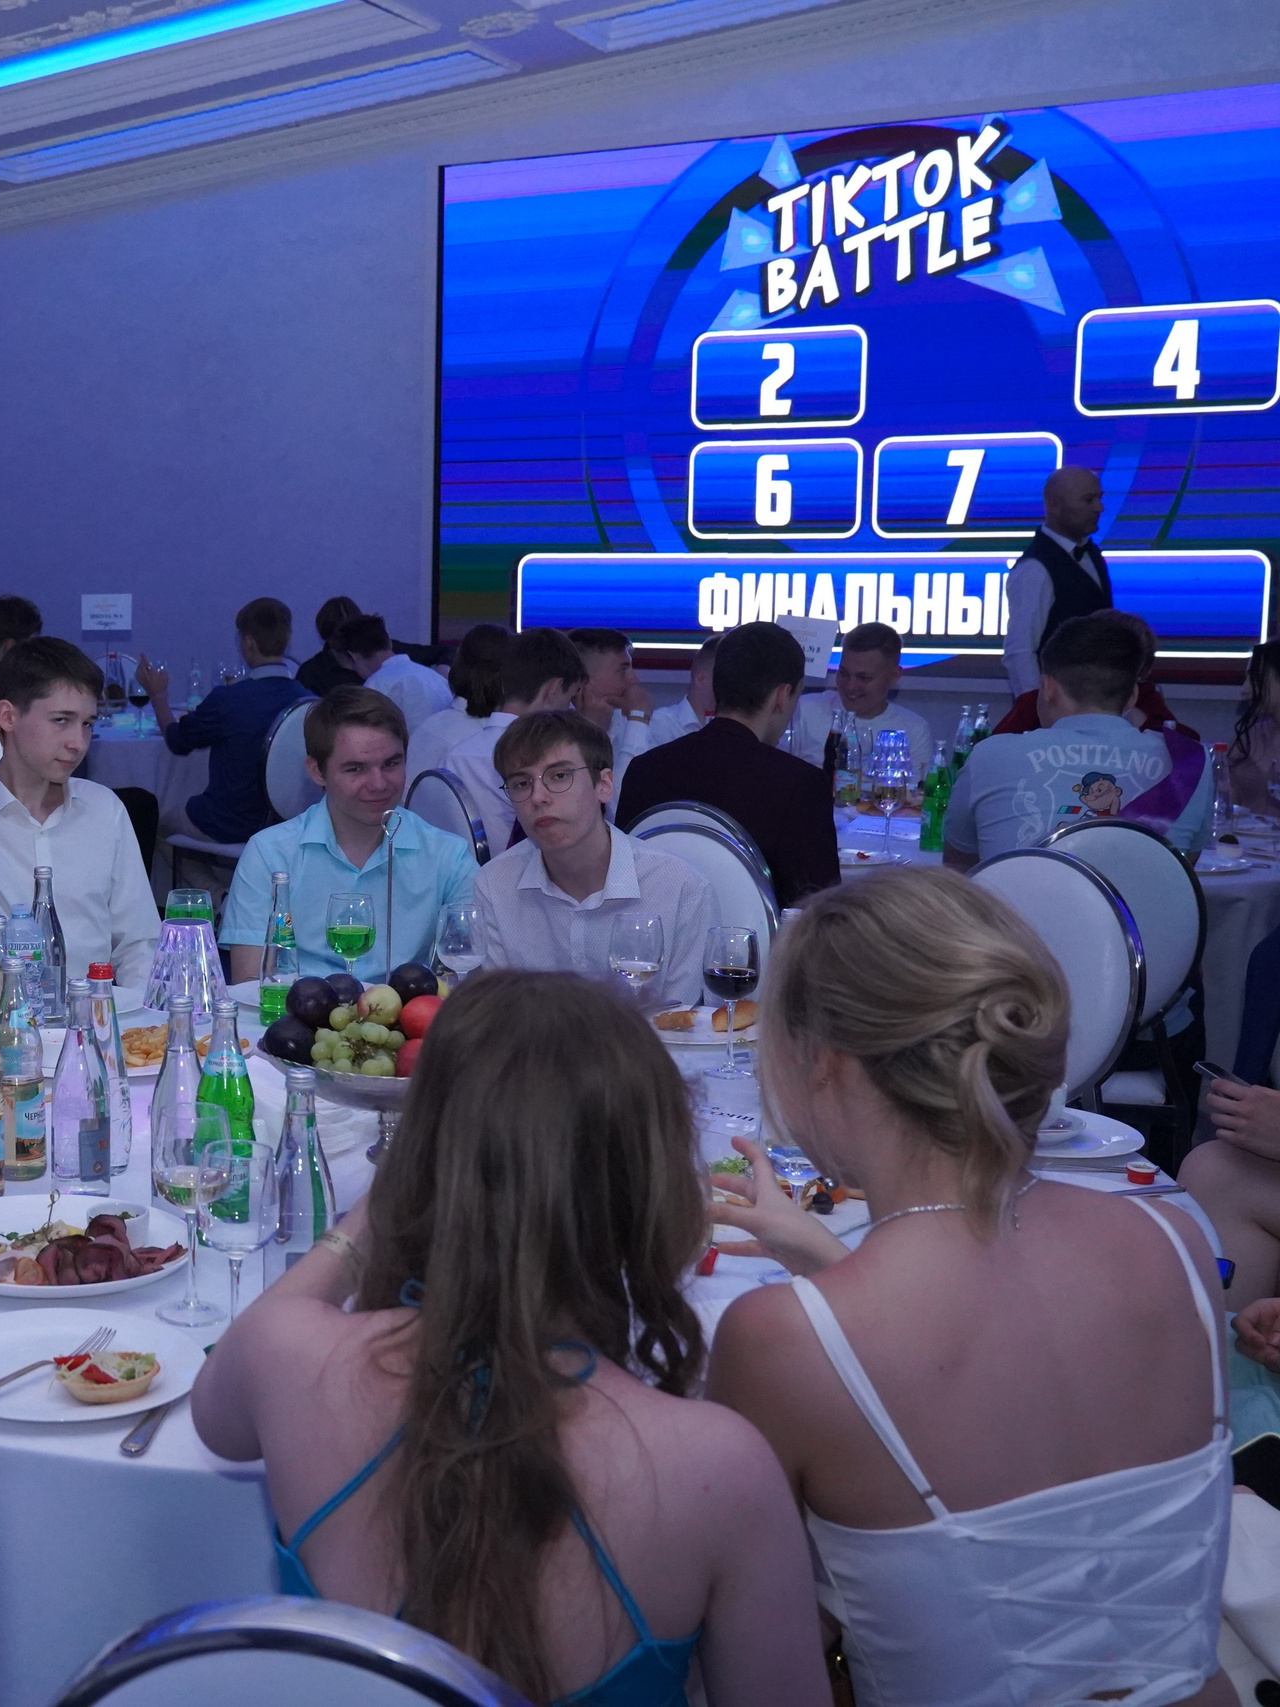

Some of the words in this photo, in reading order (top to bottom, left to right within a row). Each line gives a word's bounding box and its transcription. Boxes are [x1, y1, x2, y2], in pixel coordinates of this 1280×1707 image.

[767, 124, 1001, 253] TIKTOK
[767, 196, 994, 314] BATTLE
[760, 342, 795, 417] 2
[1152, 320, 1201, 400] 4
[754, 454, 792, 527] 6
[946, 449, 986, 526] 7
[698, 565, 1011, 636] ФИНАЛЬНЫ
[1026, 743, 1165, 780] POSITANO
